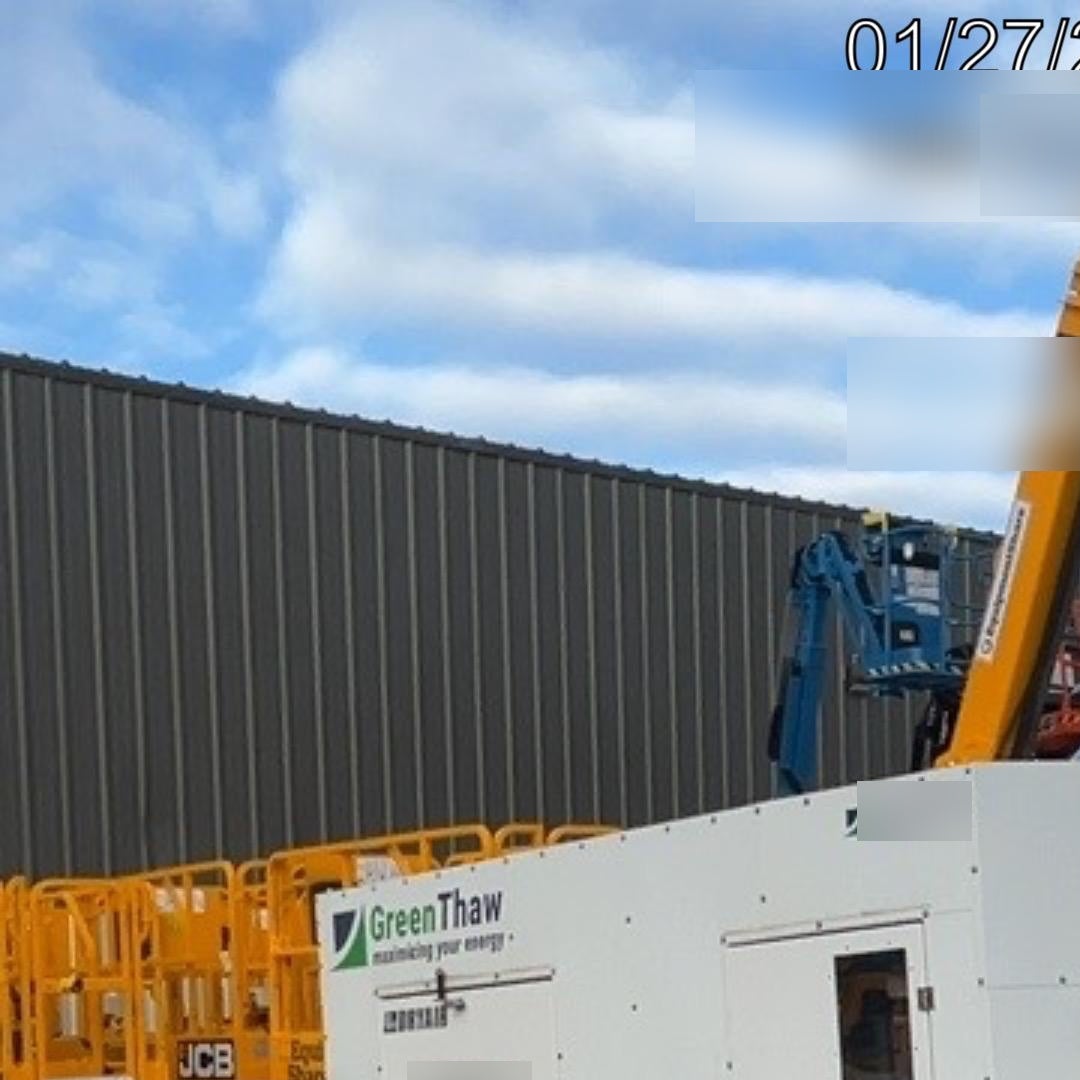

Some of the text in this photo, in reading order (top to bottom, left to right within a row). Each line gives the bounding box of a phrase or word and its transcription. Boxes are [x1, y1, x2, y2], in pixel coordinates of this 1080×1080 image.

[370, 888, 503, 942] GreenThaw
[437, 937, 462, 961] your
[179, 1042, 234, 1078] JCB
